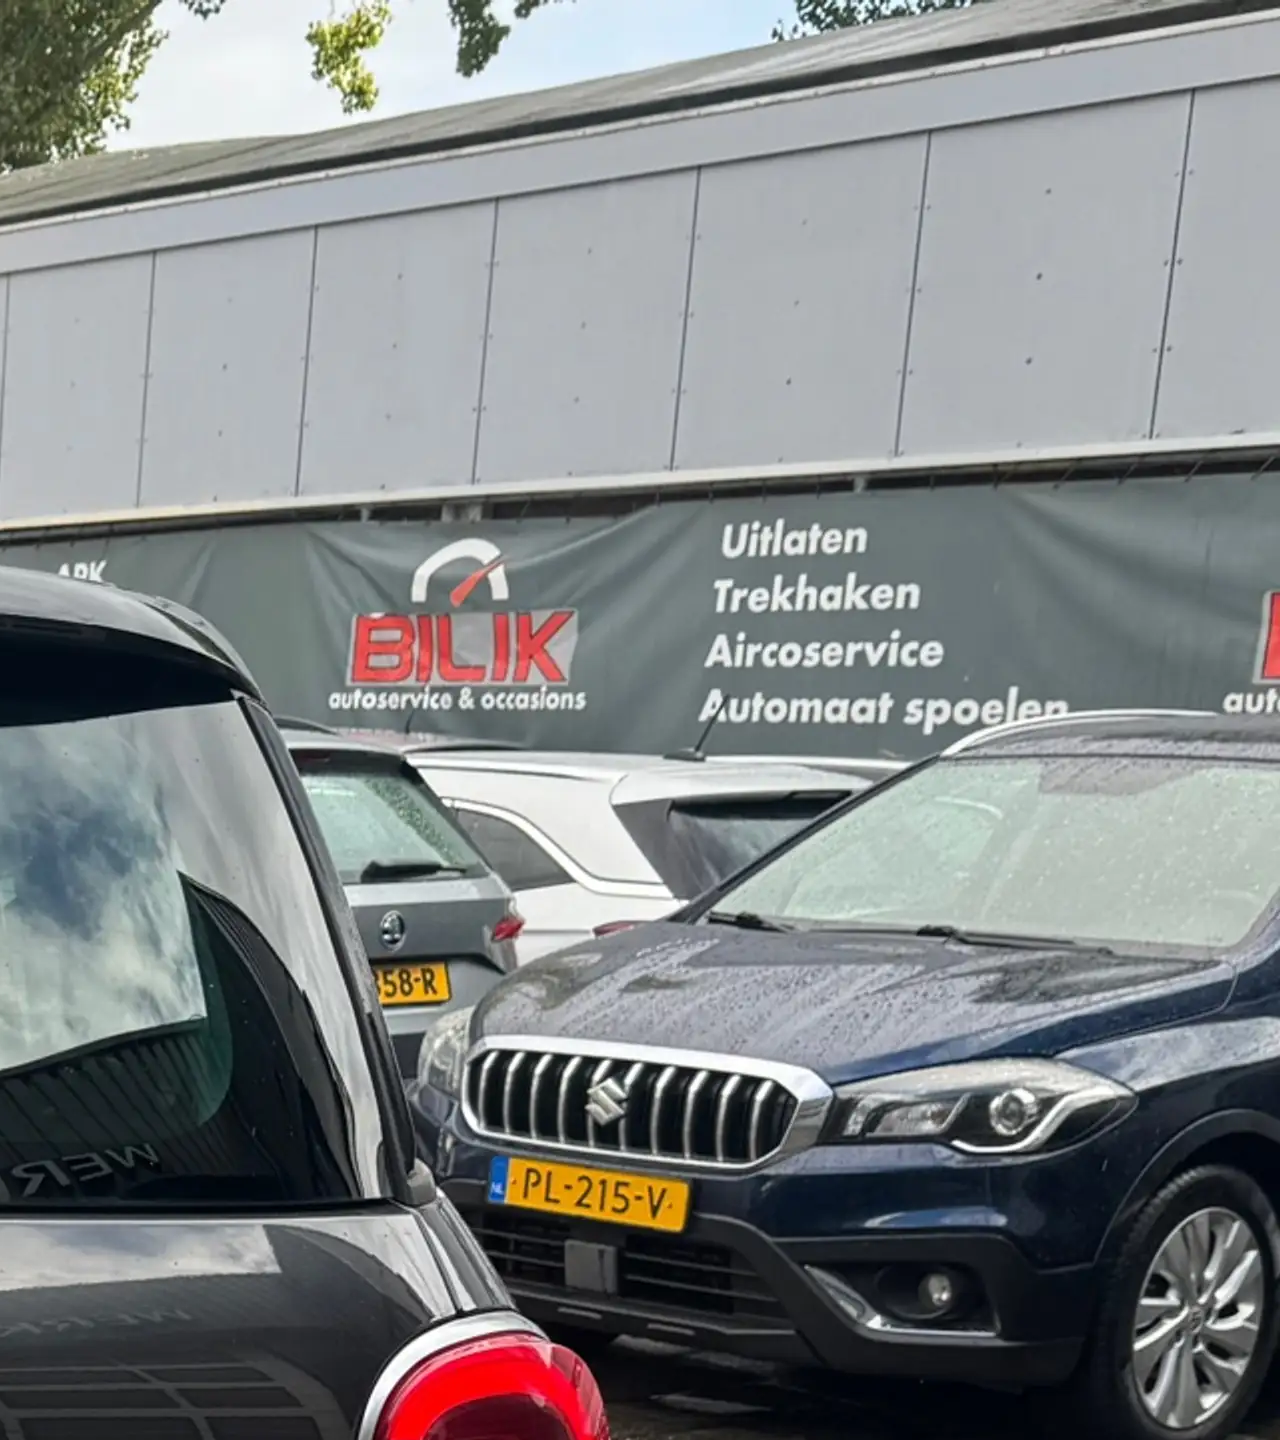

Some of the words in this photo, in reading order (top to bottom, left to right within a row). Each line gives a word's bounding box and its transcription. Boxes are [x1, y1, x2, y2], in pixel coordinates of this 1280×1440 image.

[720, 518, 868, 559] Uitlaten
[713, 573, 921, 613] Trekhaken
[351, 609, 576, 684] BILIK
[704, 629, 944, 668] Aircoservice
[328, 687, 453, 710] autoservice
[458, 687, 474, 709] &
[480, 684, 587, 710] occasions
[698, 688, 894, 724] Automaat
[903, 685, 1069, 736] spoelen
[375, 966, 439, 998] 58-R
[522, 1167, 668, 1221] PL-215-V
